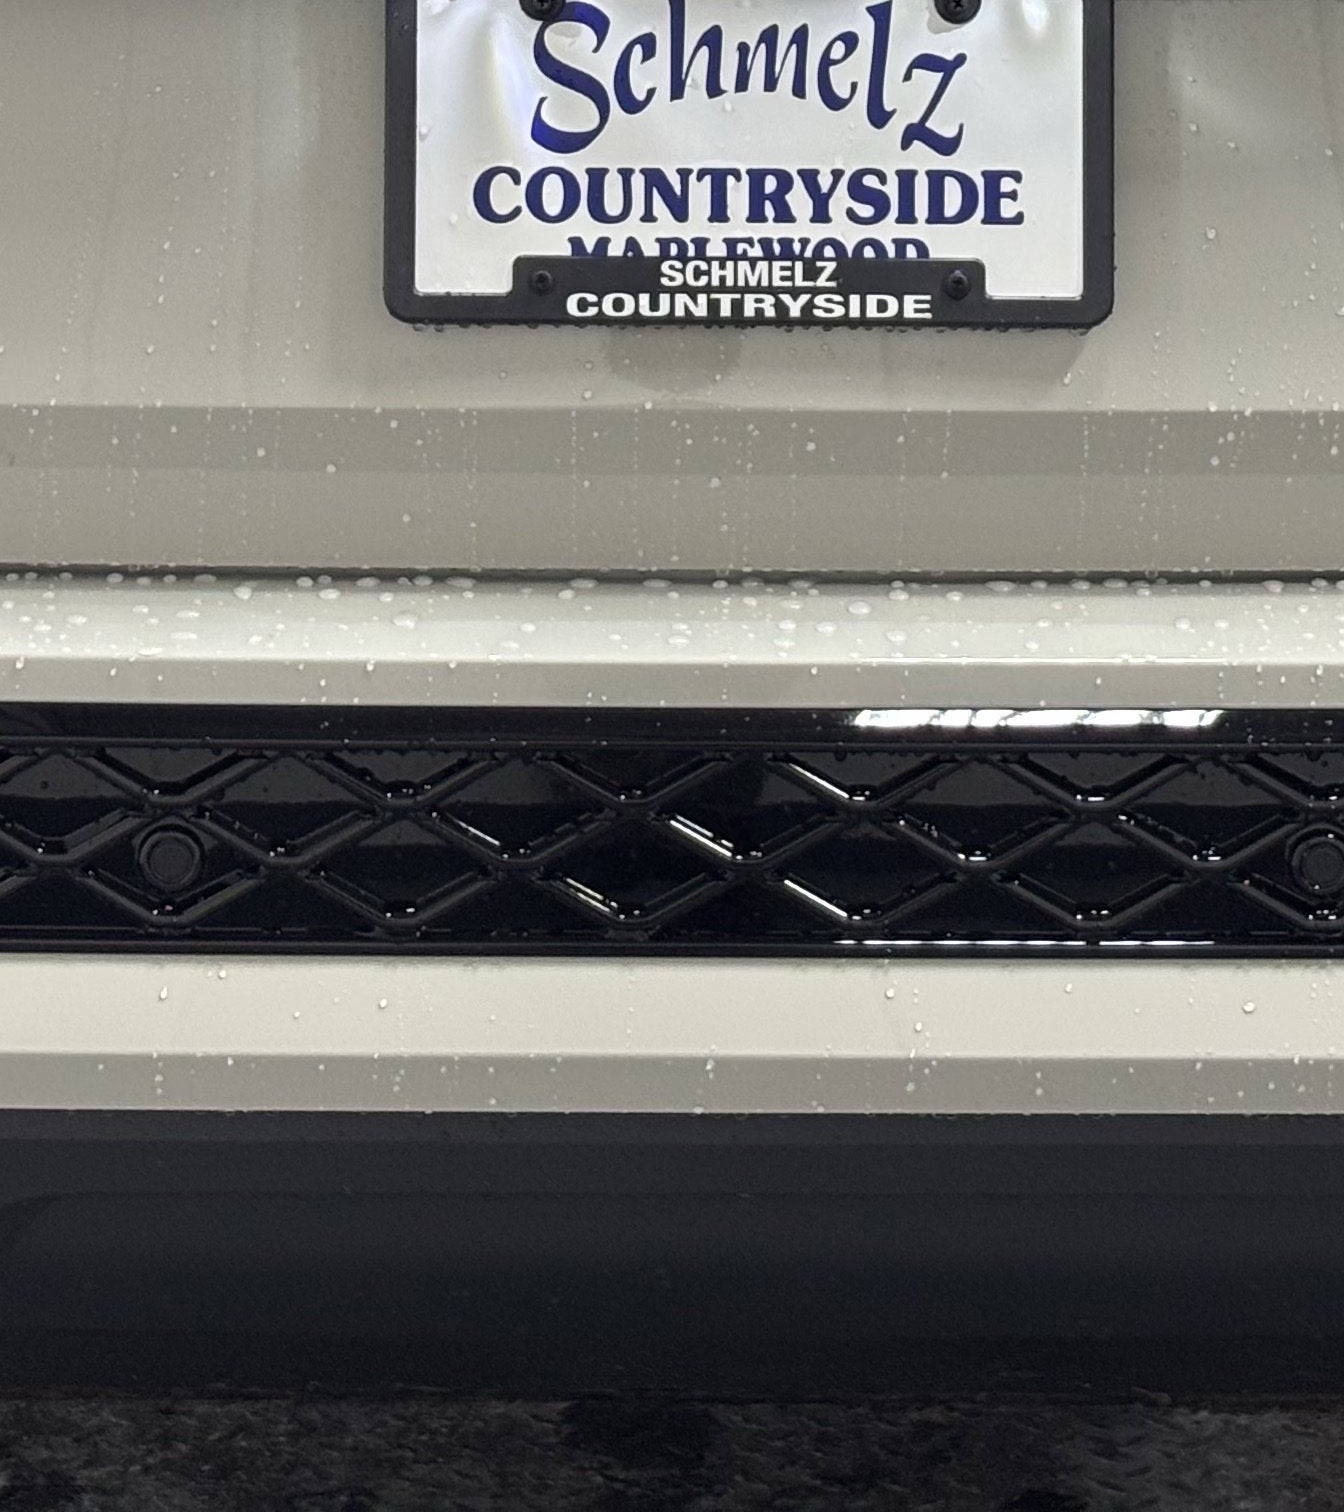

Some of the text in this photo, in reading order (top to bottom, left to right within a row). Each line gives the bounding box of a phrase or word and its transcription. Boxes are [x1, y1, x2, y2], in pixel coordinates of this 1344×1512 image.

[472, 166, 1026, 226] COUNTRYSIDE
[659, 260, 838, 288] SCHMELZ
[565, 291, 933, 320] COUNTRYSIDE
